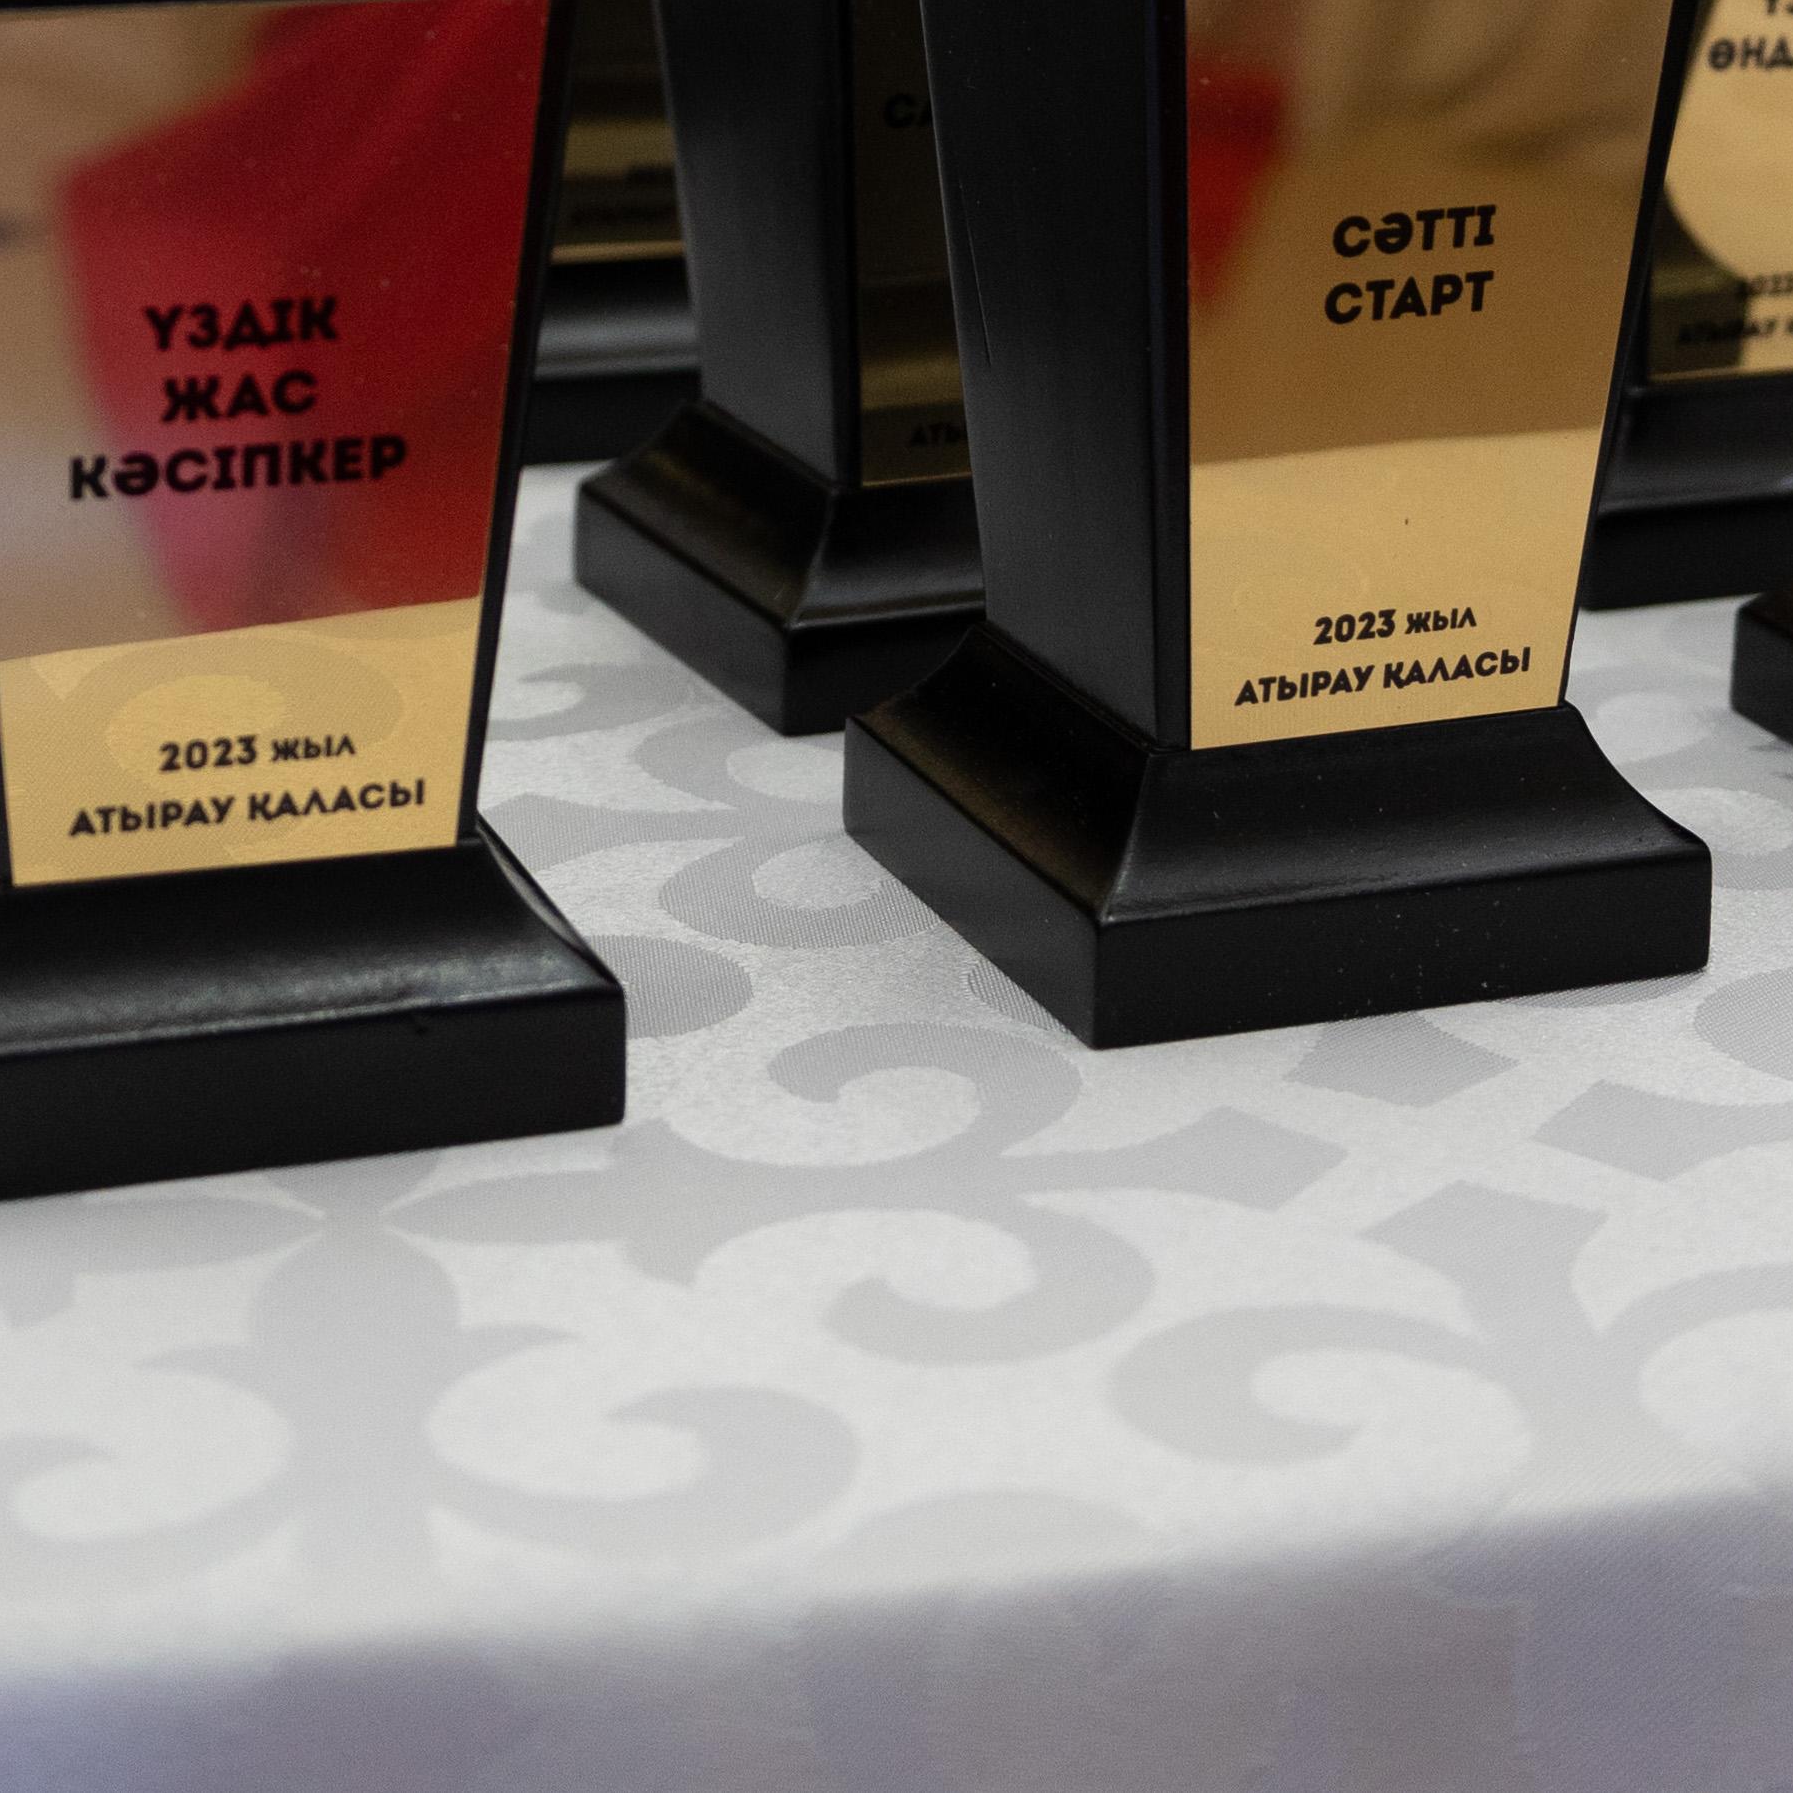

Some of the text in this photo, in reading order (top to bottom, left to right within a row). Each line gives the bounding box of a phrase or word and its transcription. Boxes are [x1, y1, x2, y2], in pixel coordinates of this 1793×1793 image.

[1332, 204, 1498, 258] СӘТТІ
[143, 296, 338, 352] ҮЗДІК
[1324, 270, 1495, 325] СТАРТ
[161, 369, 318, 424] ЖАС
[70, 434, 408, 500] КӘСІПКЕР
[1313, 609, 1397, 645] 2023
[1235, 647, 1531, 706] АТЫРАУ ҚАЛАСЫ
[159, 735, 258, 773] 2023
[69, 779, 426, 837] АТЫРАУ ҚАЛАСЫ
